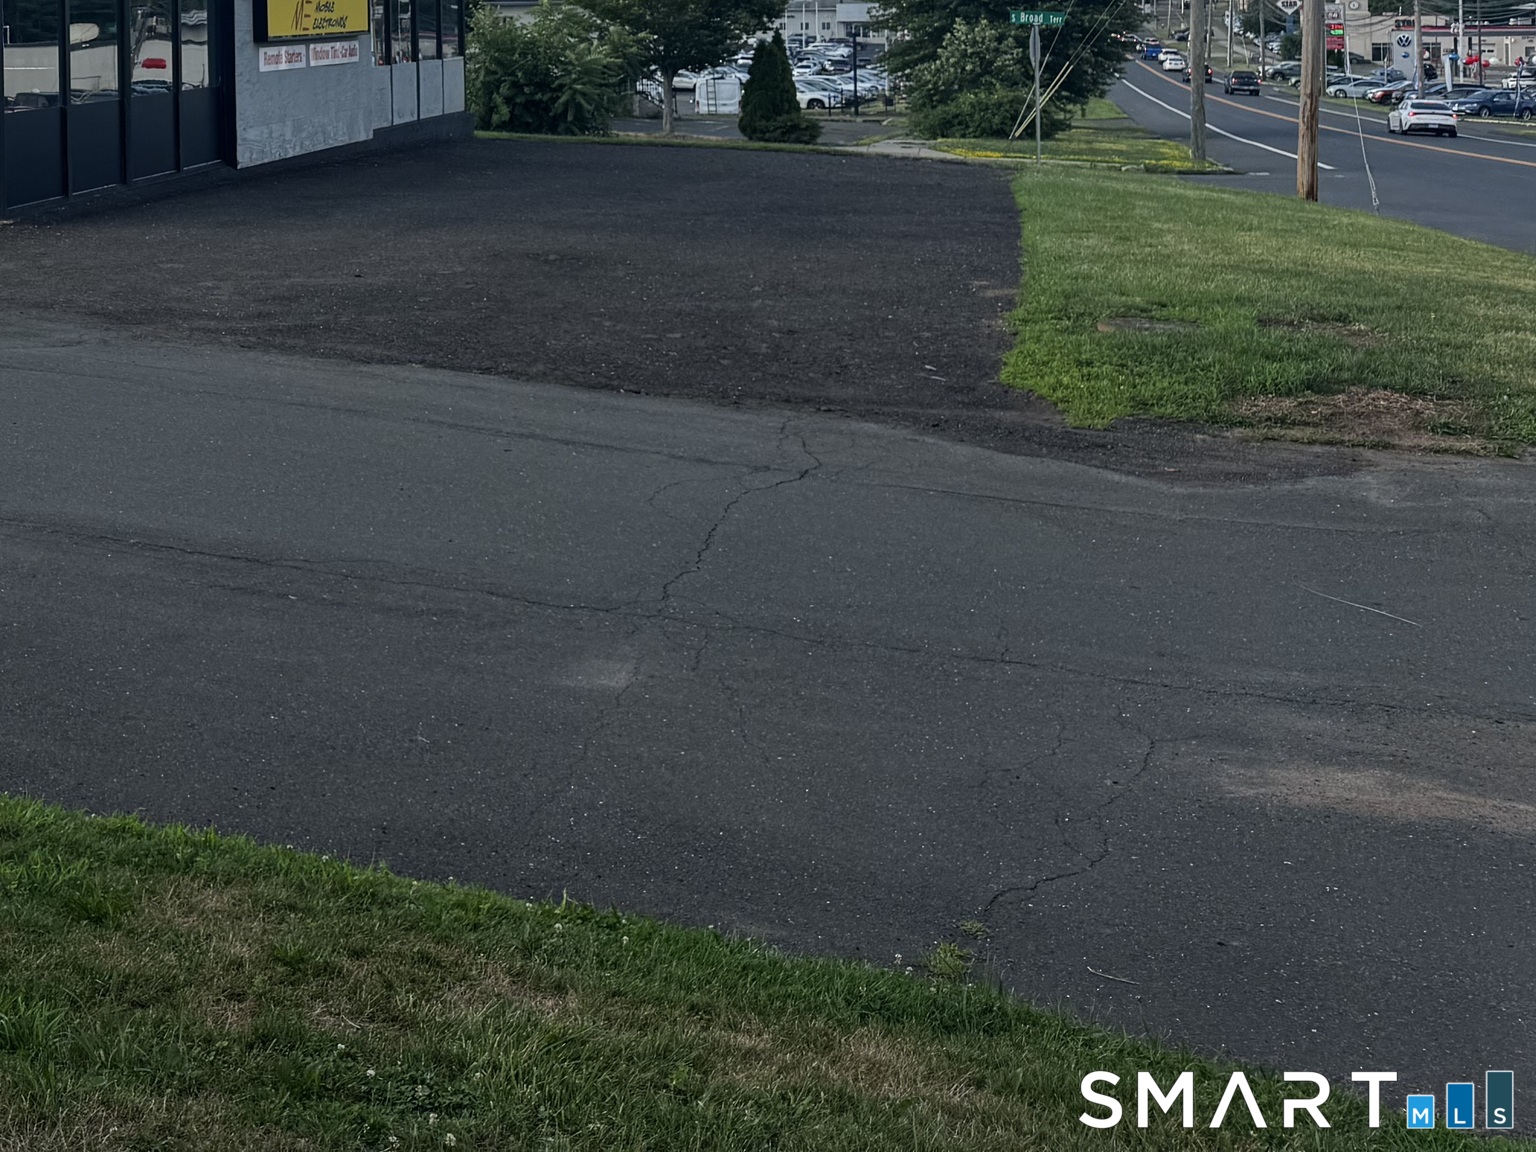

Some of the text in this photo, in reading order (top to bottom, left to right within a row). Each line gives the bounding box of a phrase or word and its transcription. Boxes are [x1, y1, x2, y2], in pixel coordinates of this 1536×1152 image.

[315, 1, 335, 13] MOBILE
[312, 15, 348, 30] ELECTRONICS
[1011, 12, 1062, 24] S Broad Terr
